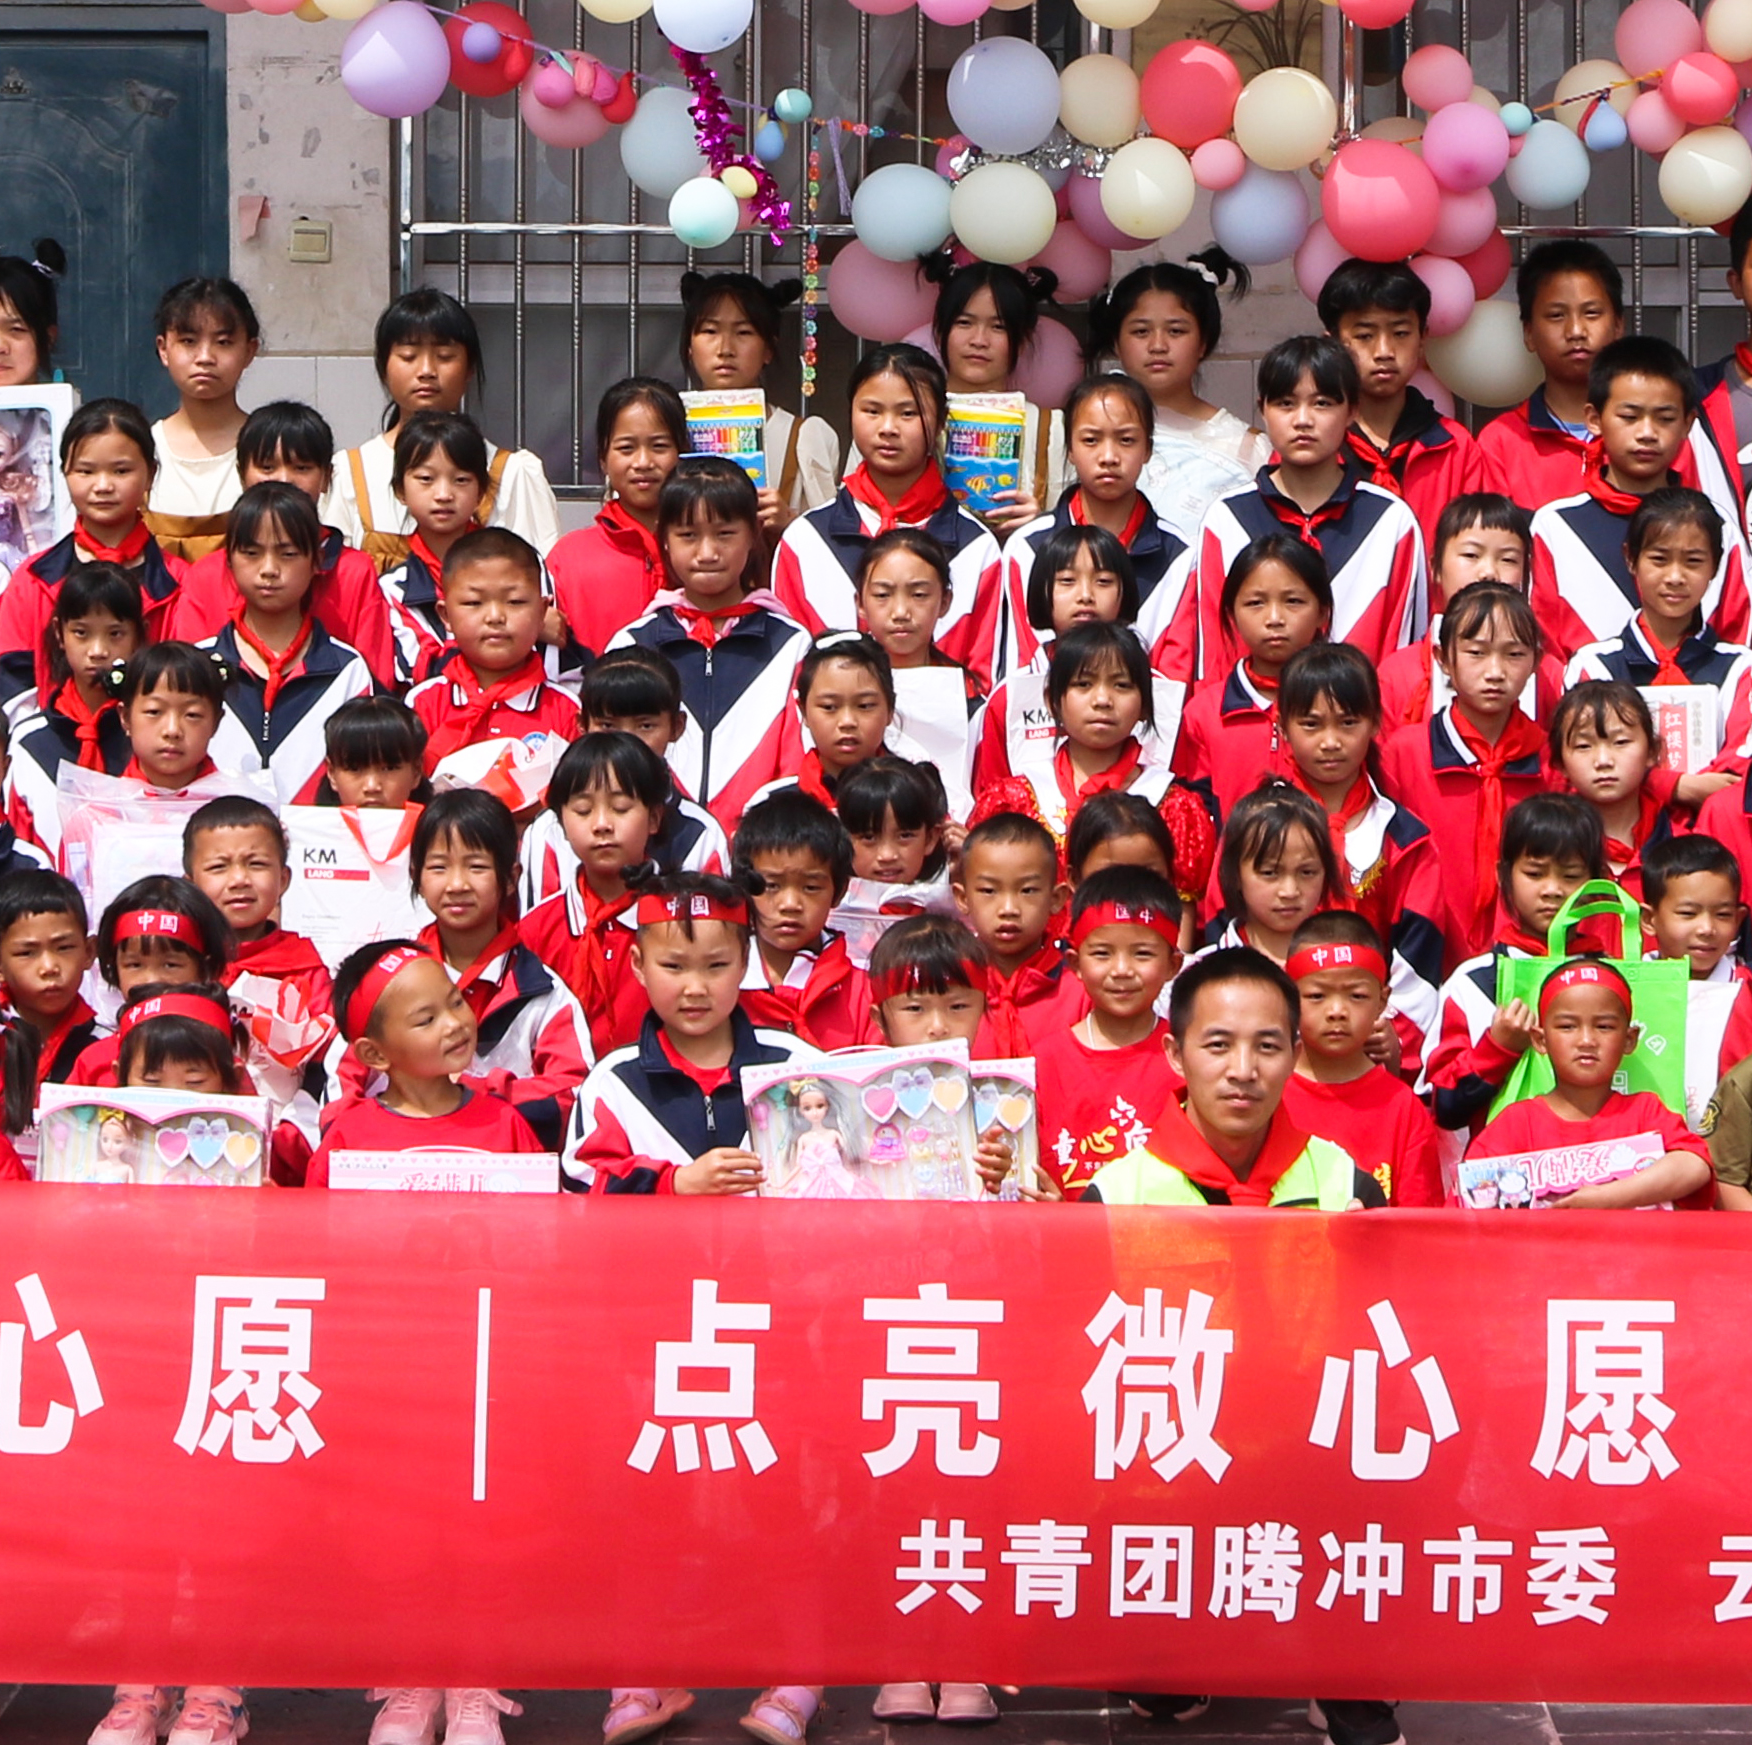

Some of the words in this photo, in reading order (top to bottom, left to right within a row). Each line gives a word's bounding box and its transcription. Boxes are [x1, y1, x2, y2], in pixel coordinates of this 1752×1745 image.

[1664, 711, 1684, 771] 红楼梦
[303, 848, 337, 865] KM
[307, 870, 335, 879] LANG
[666, 894, 710, 917] 中国
[137, 911, 179, 934] 中国
[1311, 945, 1352, 967] 中国
[1560, 967, 1599, 985] 中国
[128, 997, 162, 1023] 中国
[627, 1279, 1681, 1486] 点亮微心愿
[894, 1519, 1618, 1627] 共青团腾冲市委
